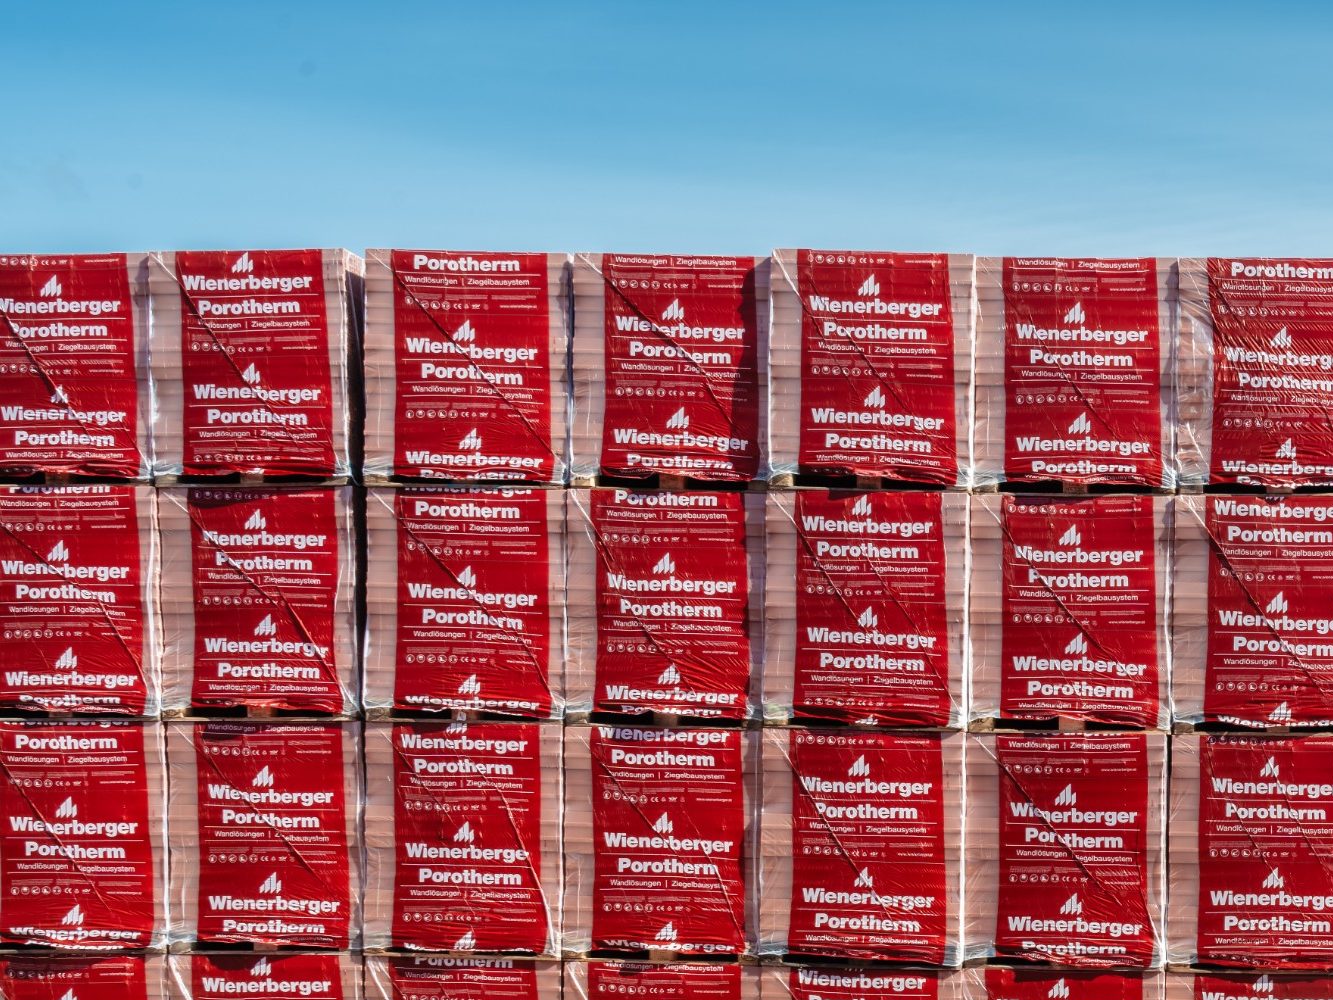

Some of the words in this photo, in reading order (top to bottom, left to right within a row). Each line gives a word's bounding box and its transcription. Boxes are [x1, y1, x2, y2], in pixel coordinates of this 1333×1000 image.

[414, 257, 519, 271] Porotherm
[616, 257, 667, 265] Wandlösungen
[676, 257, 737, 267] Ziegelbausystem
[1078, 260, 1140, 270] Ziegelbausystem
[183, 275, 312, 292] Wienerberger
[467, 277, 530, 287] Ziegelbausystem
[199, 300, 300, 315] Porotherm
[251, 319, 311, 329] Ziegelbausystem
[58, 342, 117, 352] Ziegelbausystem
[874, 347, 936, 356] Ziegelbausystem
[621, 364, 674, 372] Wandlösungen
[1080, 373, 1143, 381] Ziegelbausystem
[413, 385, 466, 394] Wandlösungen
[812, 408, 944, 430] Wienerberger
[199, 430, 251, 439] Wandlösungen
[614, 429, 748, 452] Wienerberger
[825, 434, 931, 452] Porotherm
[1016, 436, 1150, 455] Wienerberger
[406, 451, 543, 466] Wienerberger
[627, 454, 733, 469] Porotherm
[1032, 461, 1136, 474] Porotherm
[60, 498, 119, 508] Ziegelbausystem
[615, 490, 717, 506] Porotherm
[416, 501, 520, 518] Porotherm
[607, 510, 657, 519] Wandlösungen
[667, 511, 727, 520] Ziegelbausystem
[469, 523, 529, 533] Ziegelbausystem
[803, 516, 933, 537] Wienerberger
[1228, 526, 1332, 542] Porotherm
[817, 542, 918, 558] Porotherm
[8, 605, 60, 614] Wandlösungen
[621, 599, 722, 617] Porotherm
[807, 627, 936, 649] Wienerberger
[820, 653, 924, 671] Porotherm
[1013, 656, 1147, 676] Wienerberger
[1223, 658, 1277, 667] Wandlösungen
[218, 663, 319, 678] Porotherm
[5, 671, 137, 688] Wienerberger
[811, 674, 863, 683] Wandlösungen
[209, 683, 260, 692] Wandlösungen
[269, 683, 329, 693] Ziegelbausystem
[606, 685, 738, 704] Wienerberger
[1028, 681, 1133, 698] Porotherm
[16, 735, 117, 749] Porotherm
[599, 727, 730, 745] Wienerberger
[402, 734, 528, 754] Wienerberger
[1009, 741, 1060, 750] Wandlösungen
[612, 750, 714, 766] Porotherm
[414, 759, 513, 774] Porotherm
[665, 772, 725, 781] Ziegelbausystem
[801, 777, 932, 797] Wienerberger
[214, 830, 266, 840] Wandlösungen
[865, 825, 927, 834] Ziegelbausystem
[1016, 849, 1067, 858] Wandlösungen
[17, 862, 69, 872] Wandlösungen
[618, 858, 718, 874] Porotherm
[419, 869, 521, 885] Porotherm
[610, 879, 662, 888] Wandlösungen
[209, 896, 340, 914] Wienerberger
[223, 920, 325, 933] Porotherm
[815, 913, 921, 932] Porotherm
[1008, 915, 1142, 936] Wienerberger
[1224, 916, 1330, 932] Porotherm
[1022, 941, 1126, 955] Porotherm
[203, 978, 331, 995] Wienerberger
[799, 970, 926, 991] Wienerberger
